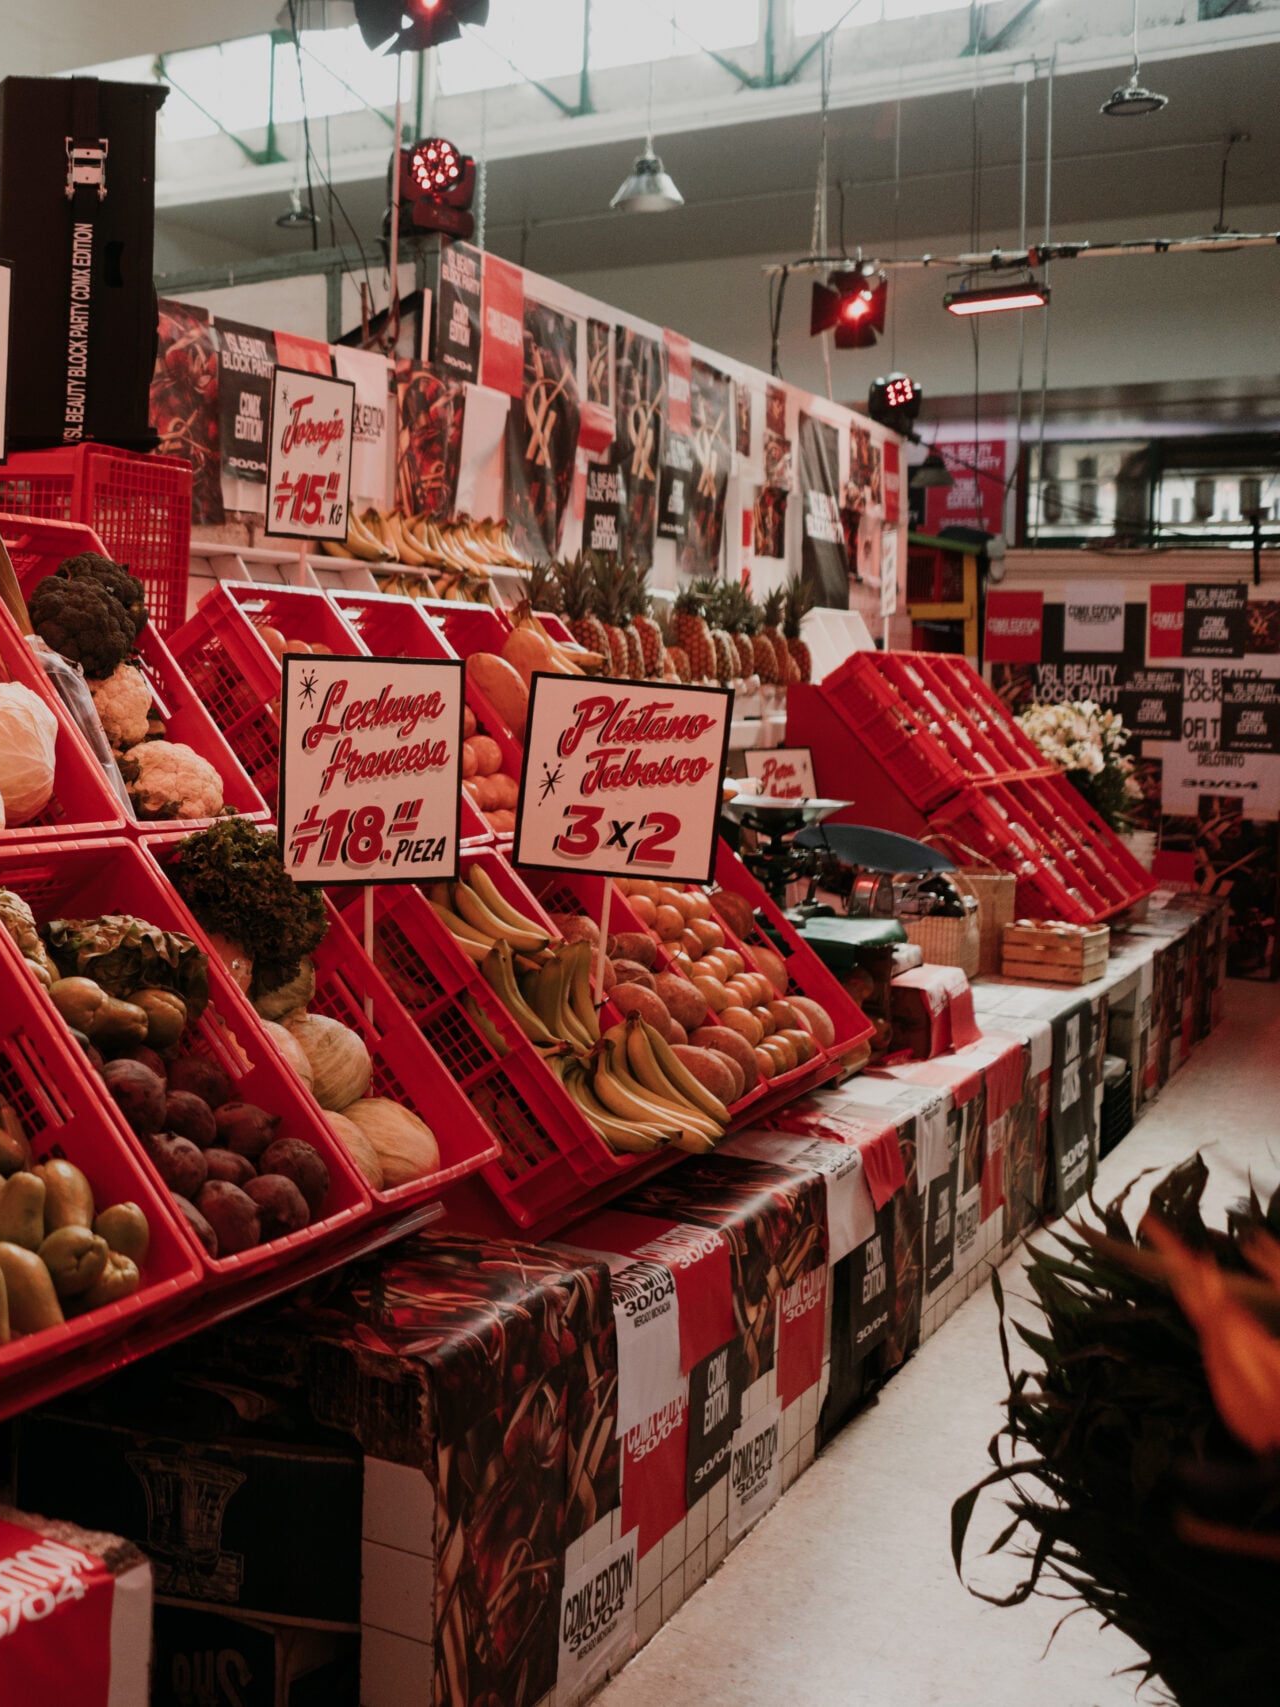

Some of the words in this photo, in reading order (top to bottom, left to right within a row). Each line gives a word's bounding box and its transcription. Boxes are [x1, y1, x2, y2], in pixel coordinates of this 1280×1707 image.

[72, 223, 94, 267] EDITION
[70, 268, 91, 300] CDMX
[68, 301, 90, 338] PARTY
[67, 339, 88, 377] BLOCK
[222, 351, 250, 374] BLOCK
[251, 357, 273, 379] PART
[64, 378, 86, 423] BEAUTY
[239, 391, 262, 417] CDMX
[235, 415, 264, 444] EDITION
[281, 395, 345, 457] Toranja
[328, 503, 343, 526] KG
[1037, 664, 1061, 684] YSL
[1064, 664, 1118, 685] BEAUTY
[1184, 669, 1208, 686] YSL
[1032, 685, 1075, 702] LOCK
[1080, 685, 1121, 703] PART
[302, 679, 446, 755] Lechuga
[580, 748, 715, 797] Tabasco
[1181, 778, 1259, 790] 30/04
[392, 836, 447, 867] PIEZA
[675, 1232, 724, 1270] 30/04
[865, 1234, 884, 1273] CDMX
[623, 1280, 675, 1318] 30/04
[862, 1262, 887, 1306] EDITION
[785, 1292, 822, 1324] 30/04
[855, 1310, 889, 1345] 30/04
[707, 1347, 729, 1397] CDMX
[703, 1380, 731, 1437] EDITION
[632, 1413, 684, 1463] 30/04
[731, 1439, 756, 1489] CDMX
[754, 1418, 780, 1472] EDITION
[693, 1439, 733, 1484] 30/04
[736, 1460, 774, 1498] 30/04
[562, 1579, 594, 1643] CDMX
[593, 1546, 634, 1617] EDITION
[568, 1595, 625, 1654] 30/04
